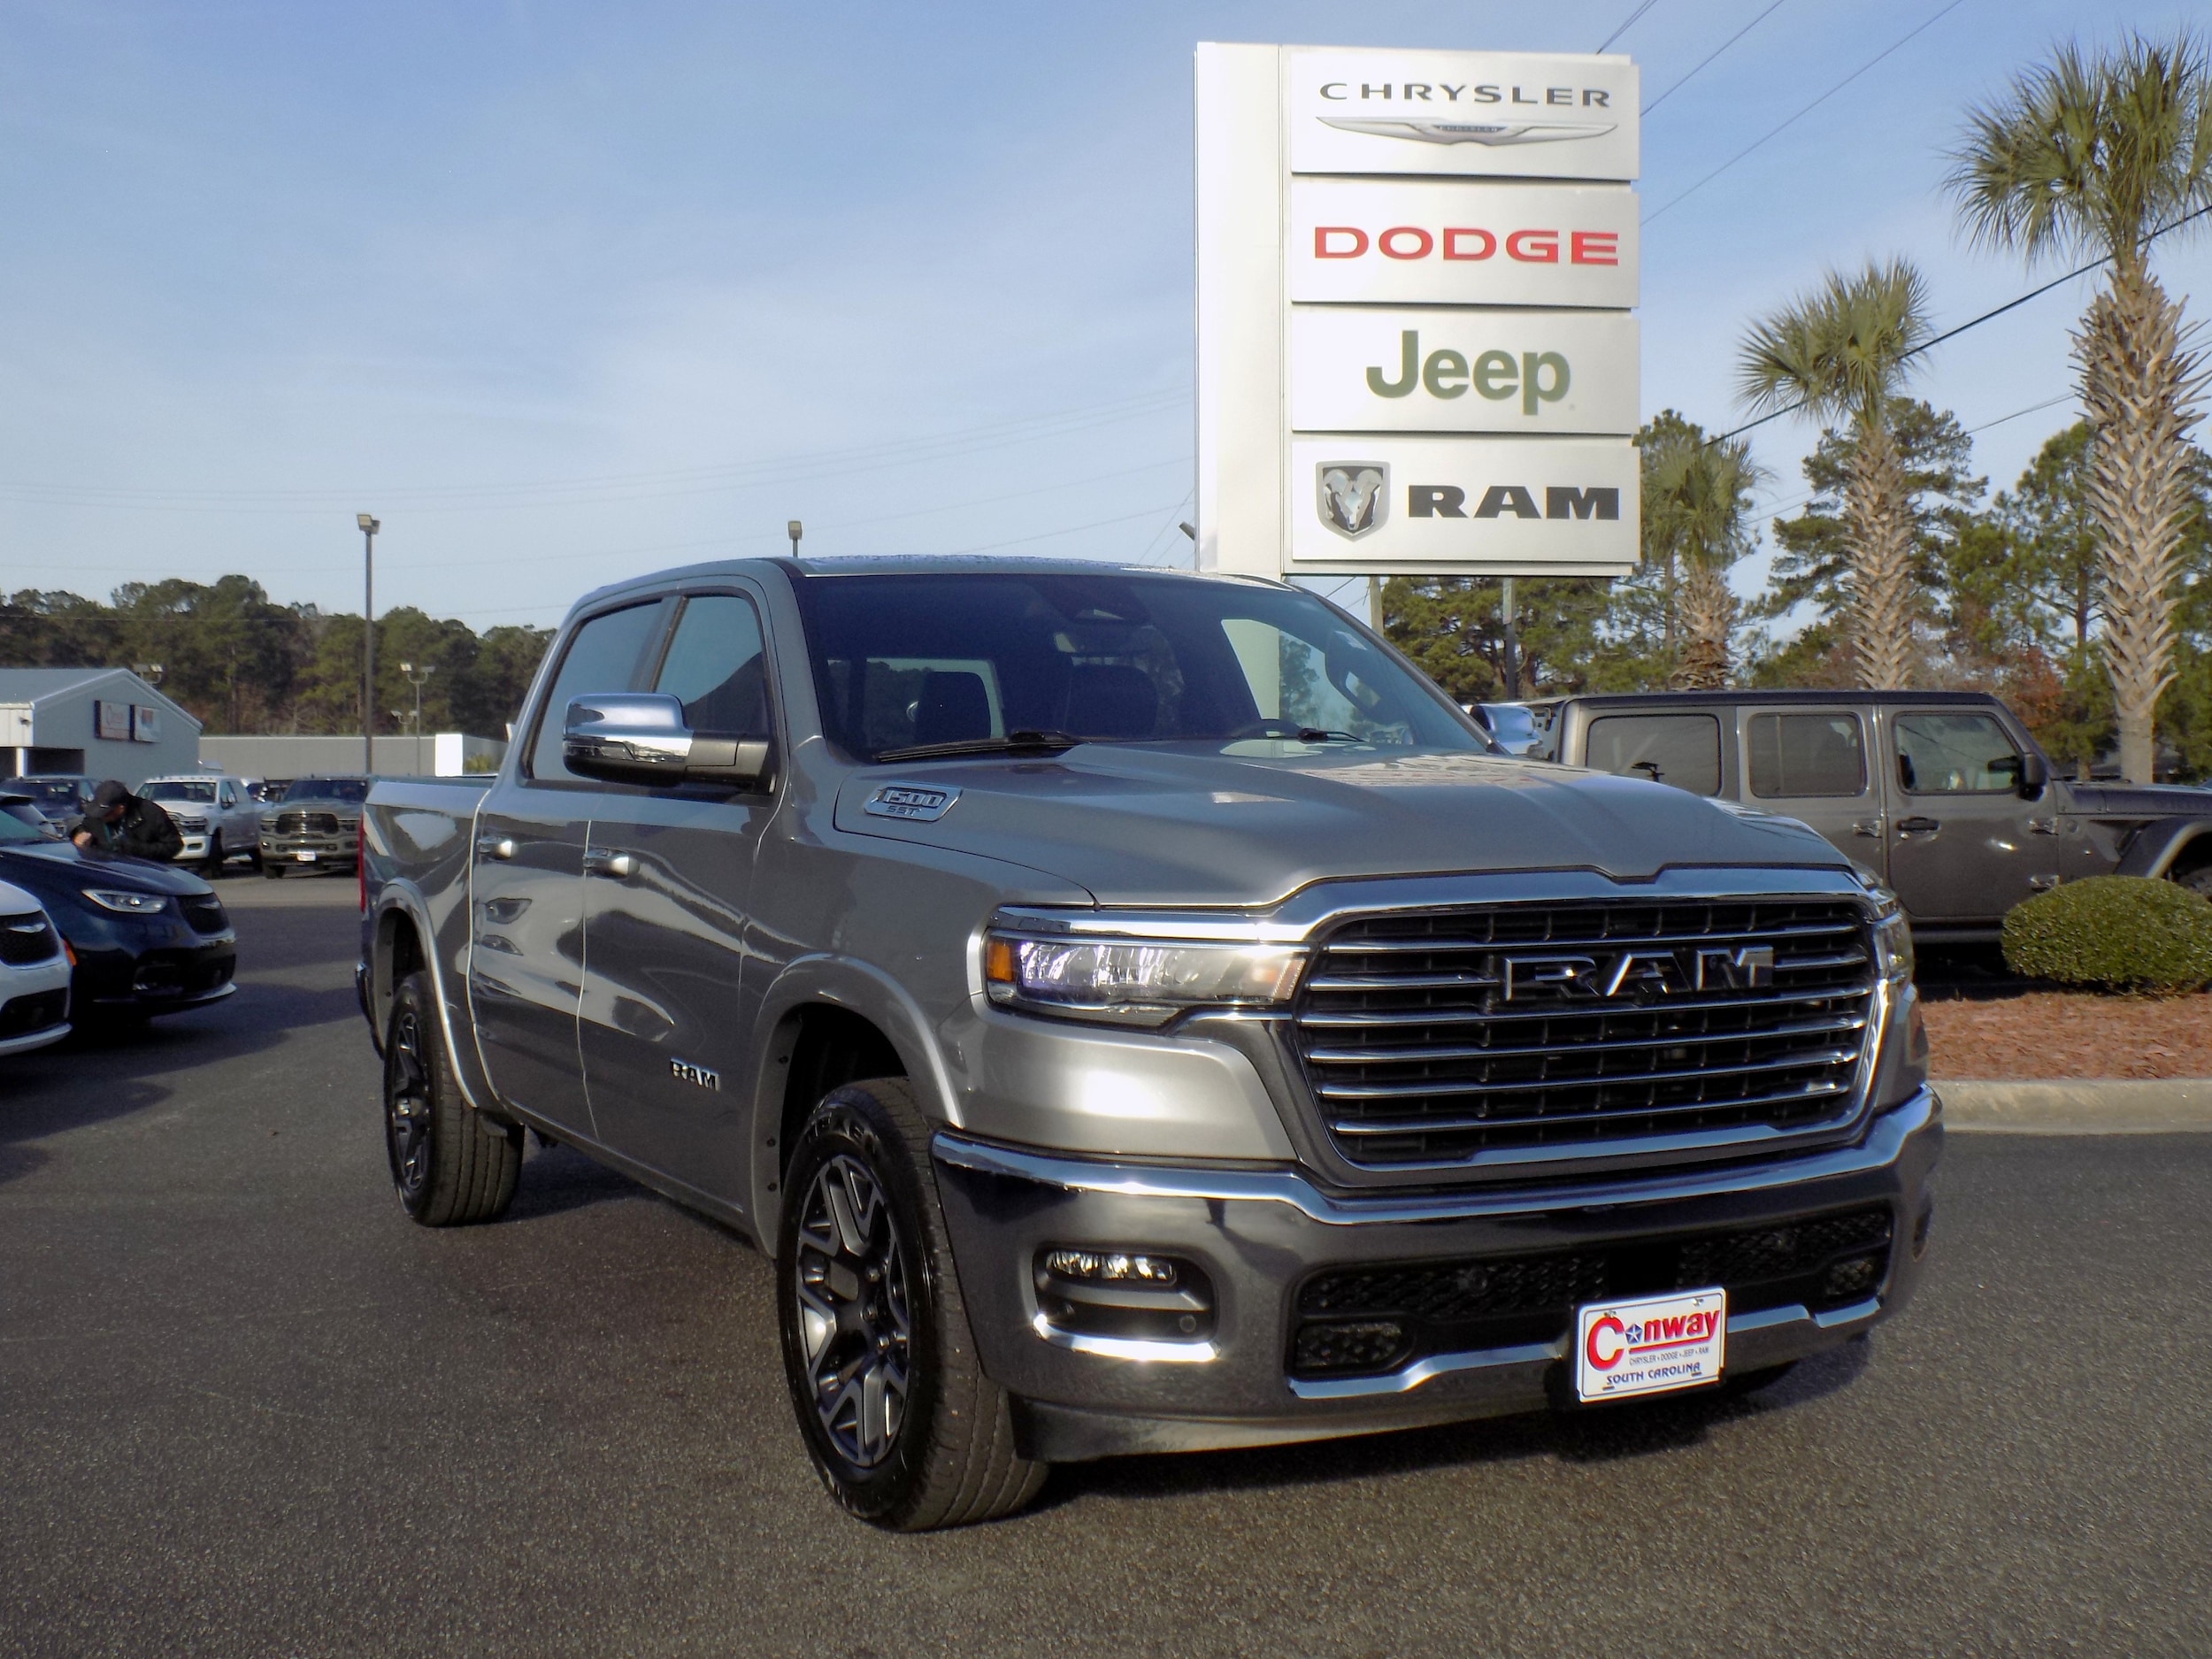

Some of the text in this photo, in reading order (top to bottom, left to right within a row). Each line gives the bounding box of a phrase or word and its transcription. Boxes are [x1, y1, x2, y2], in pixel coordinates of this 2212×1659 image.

[1319, 82, 1611, 108] CHRYSLER
[1314, 226, 1619, 266] DODGE
[1365, 329, 1571, 416] Jeep
[1408, 484, 1619, 521] RAM
[883, 787, 945, 808] 1500
[1504, 945, 1774, 1002] RAM
[669, 1056, 721, 1092] RAM
[1606, 1361, 1701, 1386] SOUTH CAROLINA
